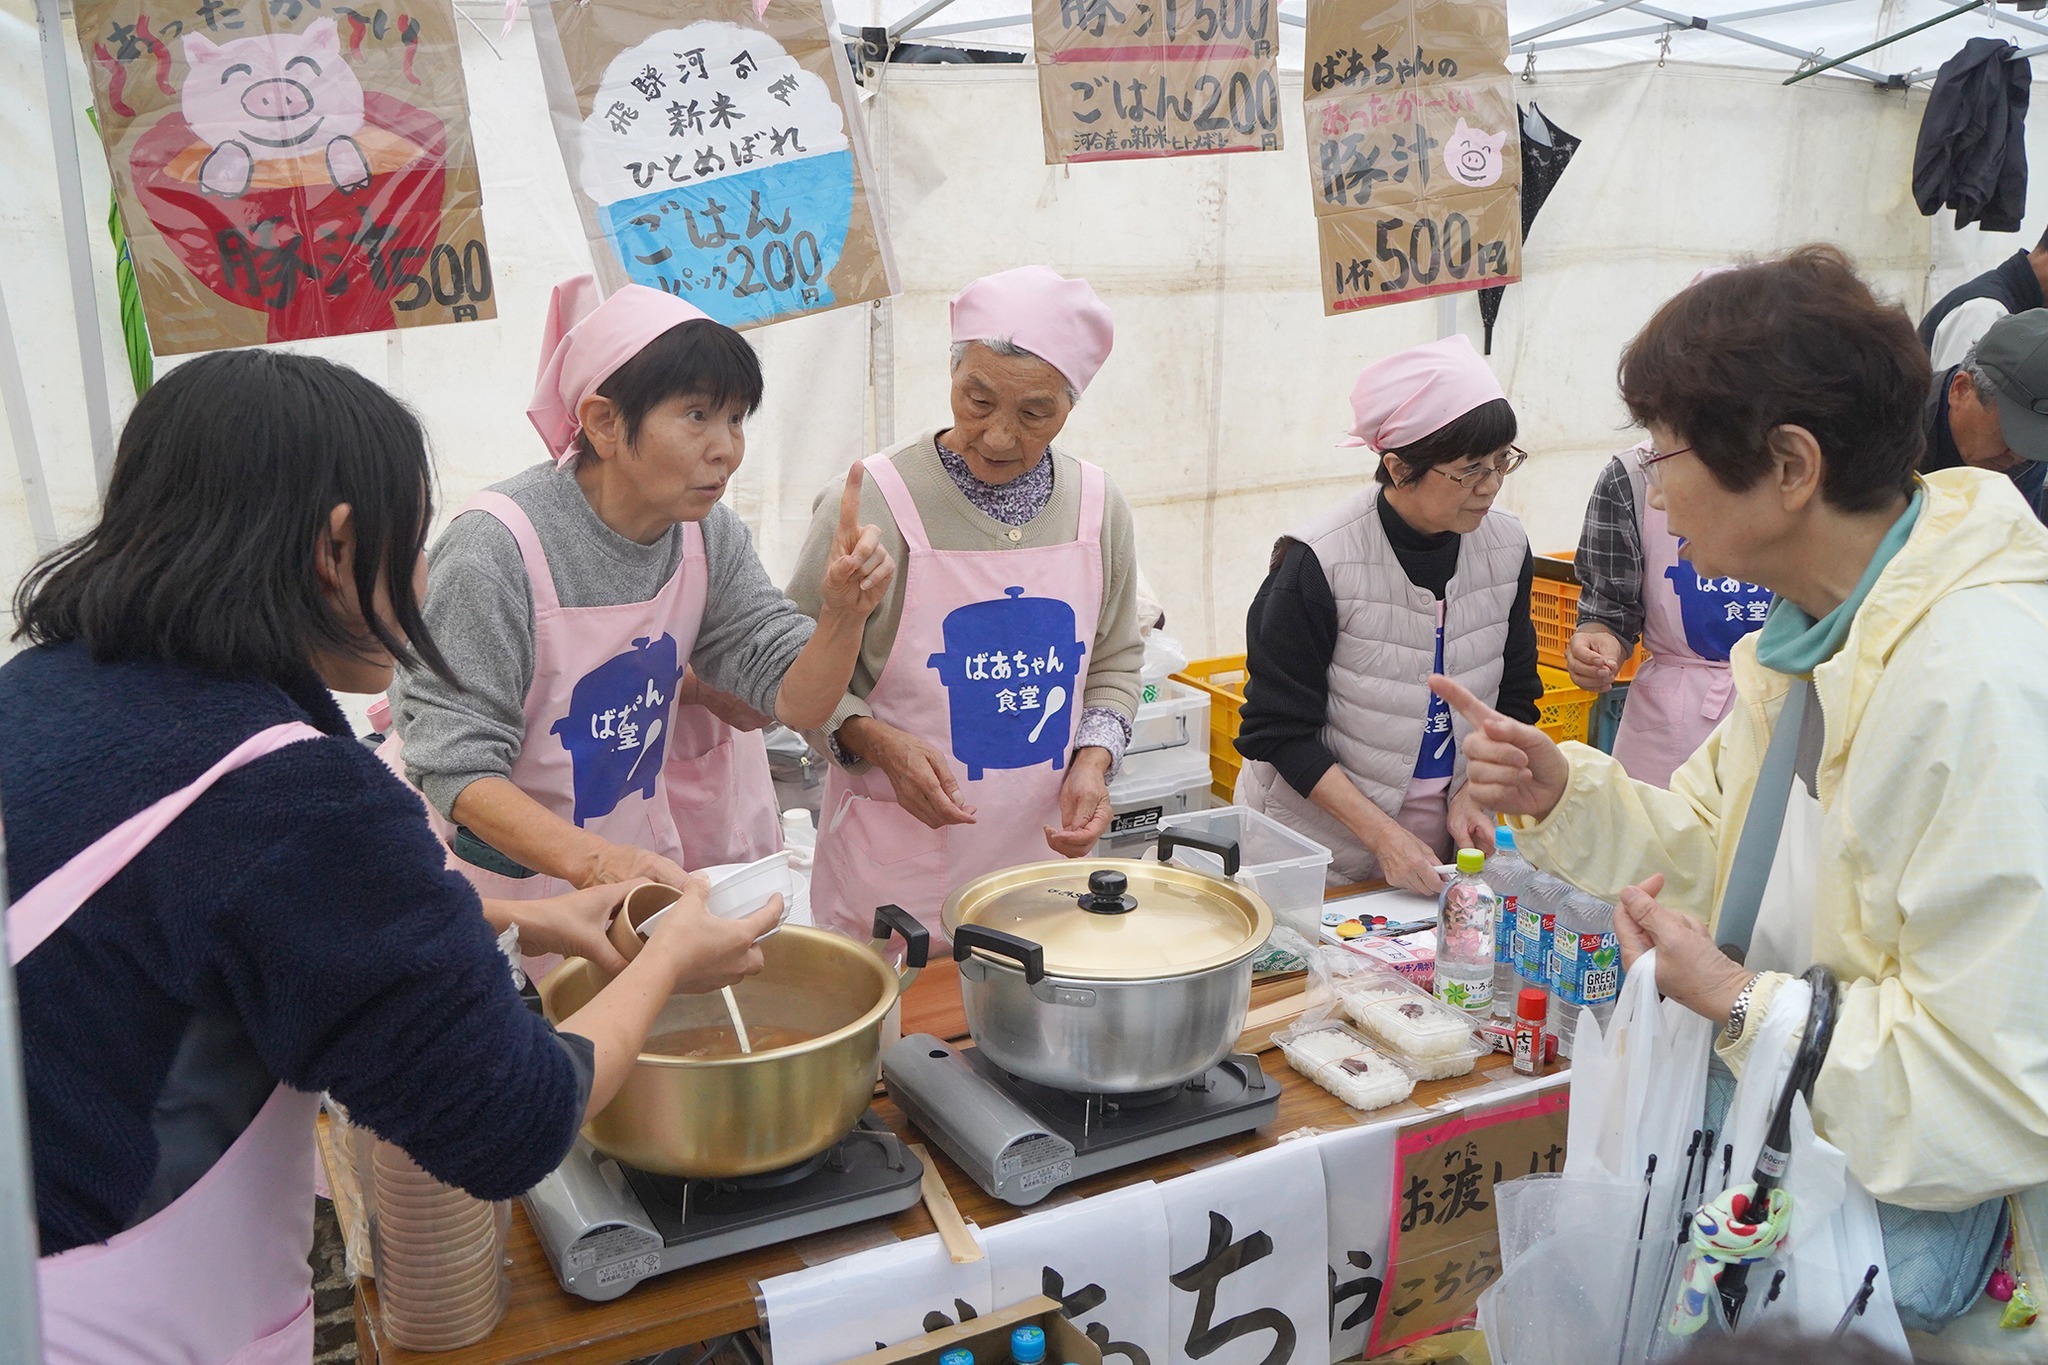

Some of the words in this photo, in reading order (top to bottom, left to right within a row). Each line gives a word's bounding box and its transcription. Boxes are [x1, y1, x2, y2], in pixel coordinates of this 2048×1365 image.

[1311, 44, 1458, 92] ばあちゃんの
[665, 91, 746, 138] 新米
[623, 126, 808, 189] ひとめぼれ
[1319, 123, 1439, 206] 豚汁
[628, 189, 793, 266] ごはん
[1723, 600, 1769, 622] 食堂
[965, 645, 1064, 681] ばあちゃん
[995, 685, 1041, 714] 食堂
[1133, 812, 1158, 828] 22
[1601, 932, 1619, 949] 60
[1587, 970, 1616, 986] GREEN
